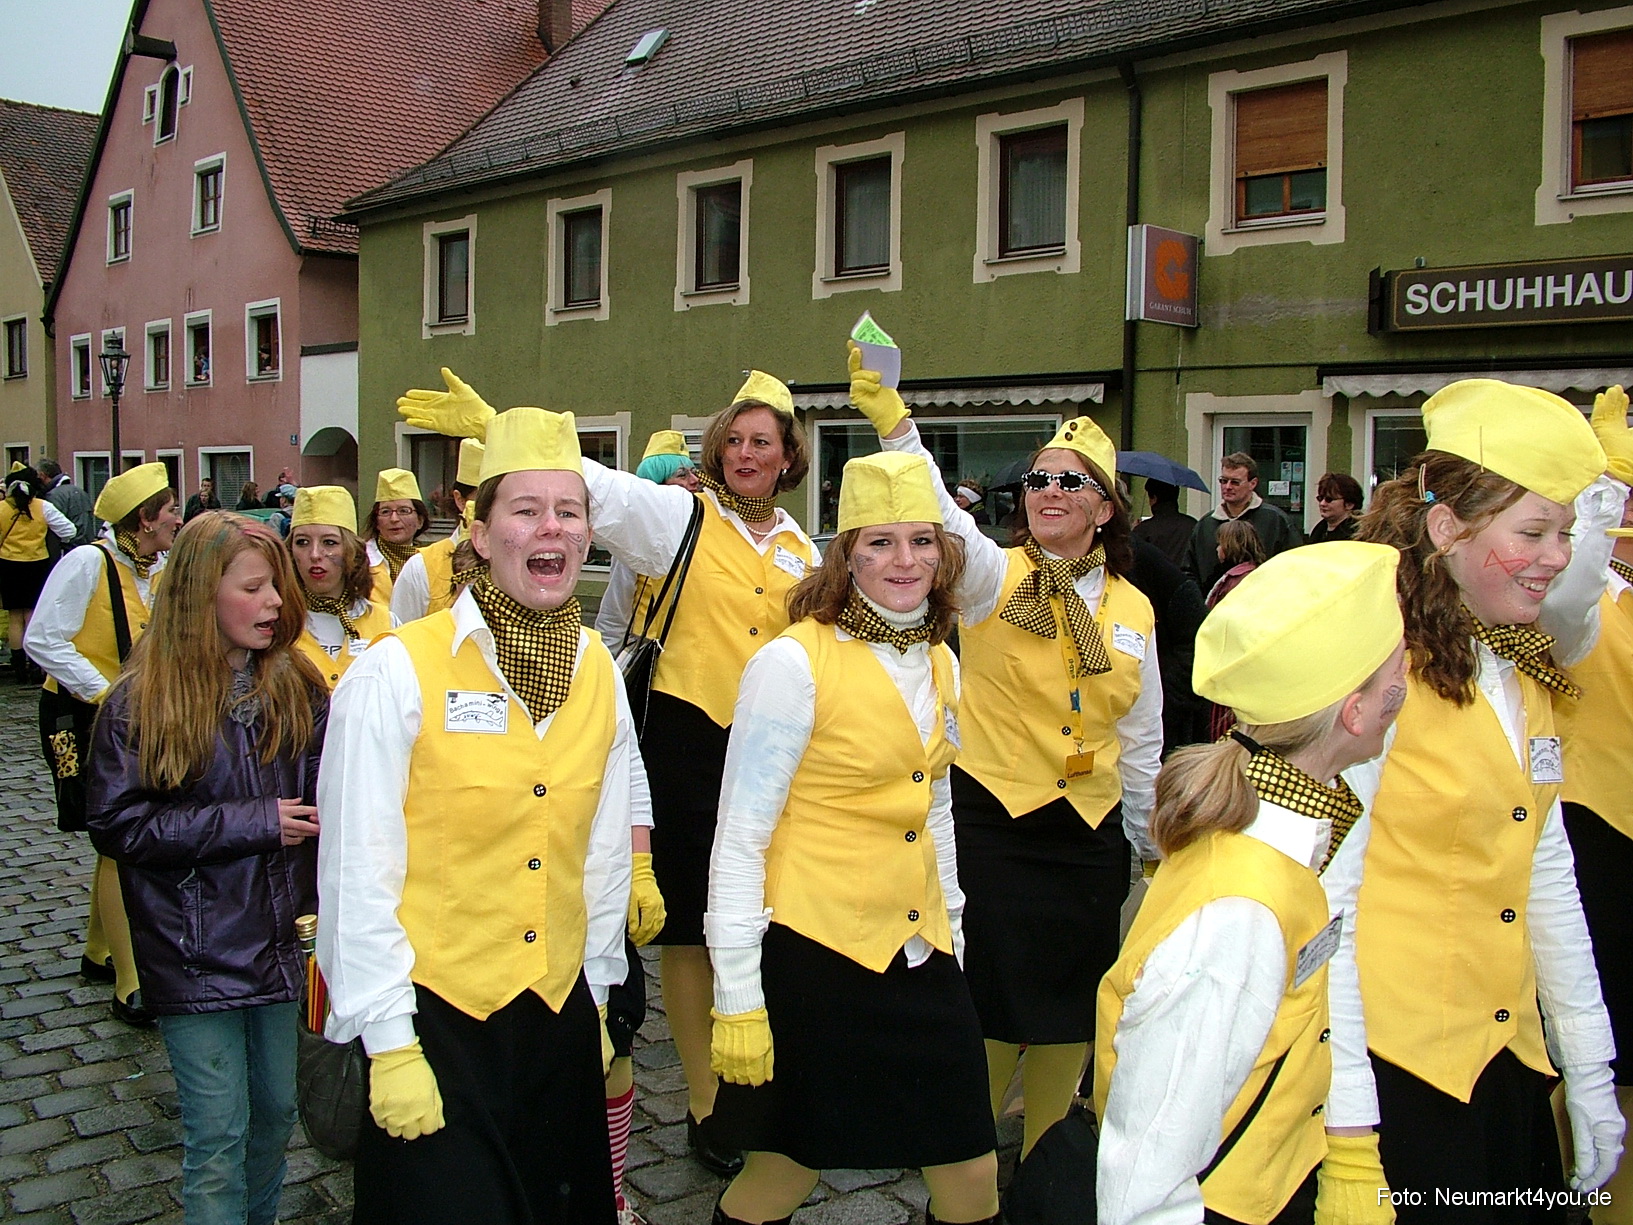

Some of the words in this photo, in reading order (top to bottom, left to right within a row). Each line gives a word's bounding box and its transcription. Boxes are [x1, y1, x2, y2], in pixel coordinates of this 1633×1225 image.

[1404, 269, 1633, 315] SCHUHHAU
[1149, 301, 1172, 313] GARANT
[1172, 305, 1192, 316] SCHUH
